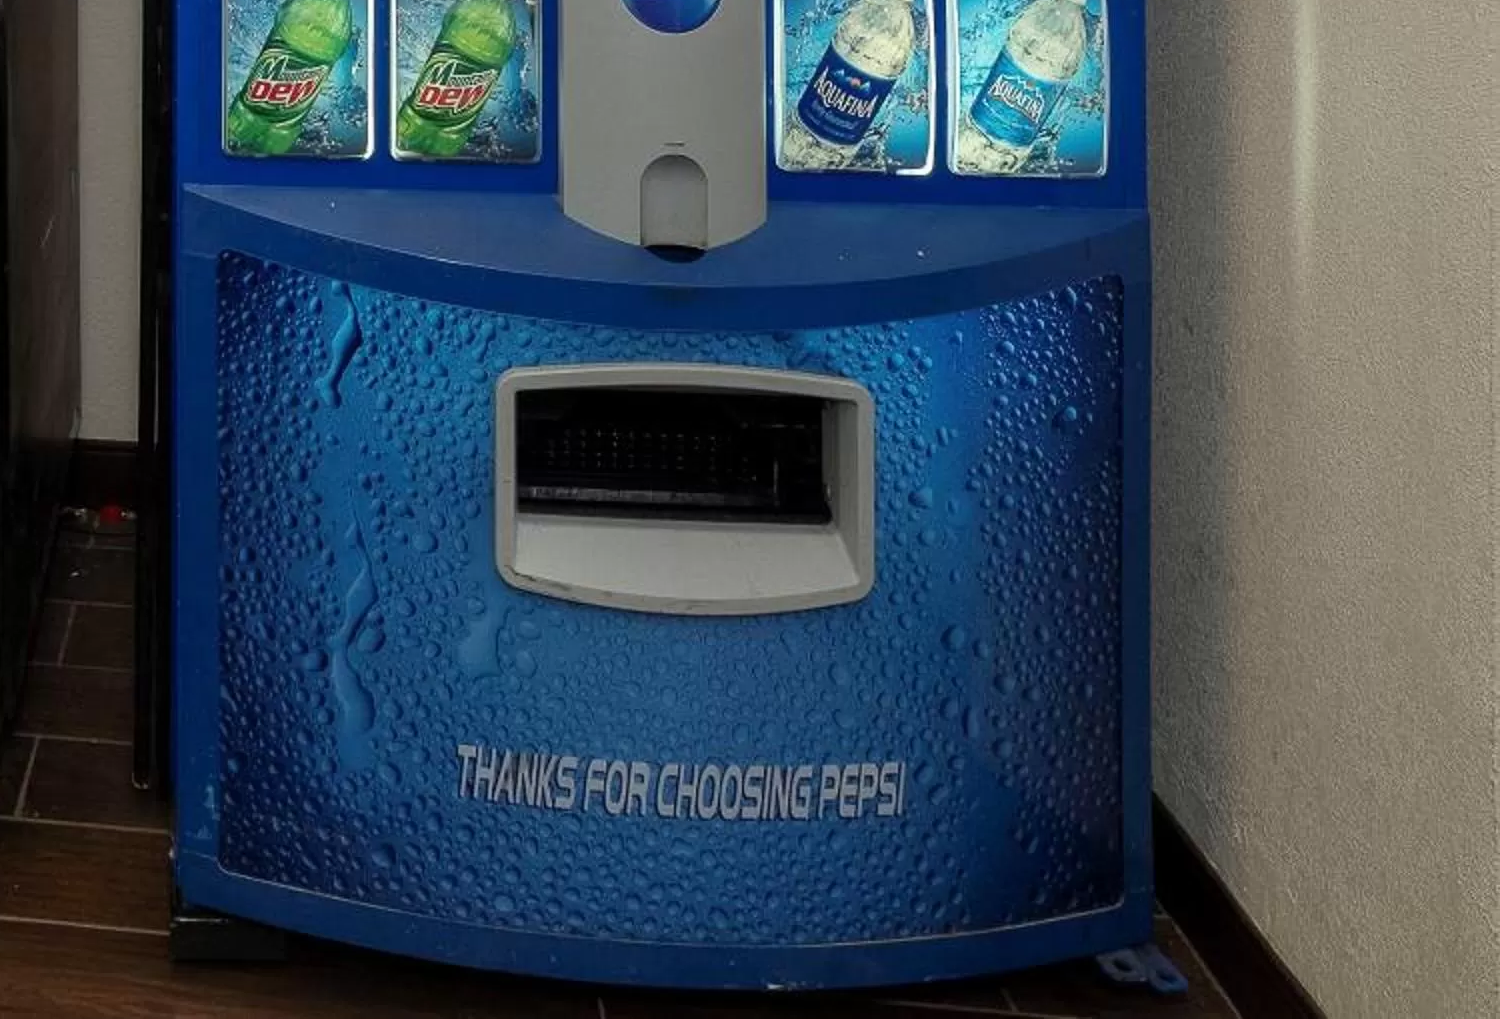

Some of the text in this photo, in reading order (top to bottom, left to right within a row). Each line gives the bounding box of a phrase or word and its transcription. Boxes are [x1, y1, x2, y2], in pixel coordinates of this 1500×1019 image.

[812, 65, 875, 120] AQUAFINA
[988, 73, 1046, 123] AQUAFINA
[457, 744, 907, 821] THANKS FOR CHOOSING PEPSI
